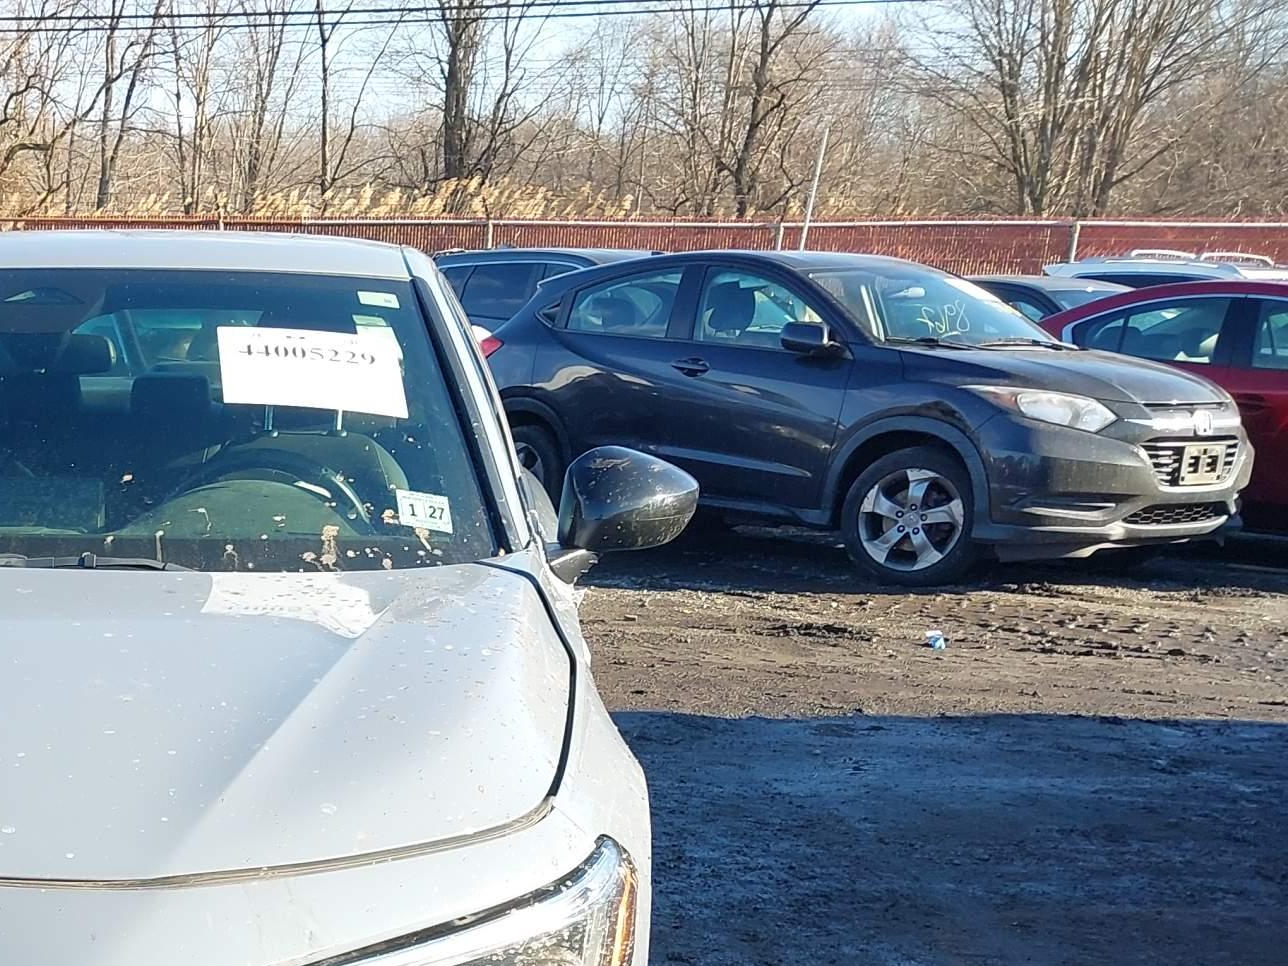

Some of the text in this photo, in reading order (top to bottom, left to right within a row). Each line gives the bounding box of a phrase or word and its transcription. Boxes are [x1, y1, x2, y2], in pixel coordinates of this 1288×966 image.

[238, 344, 376, 365] 44005229
[409, 503, 445, 521] 1 27
